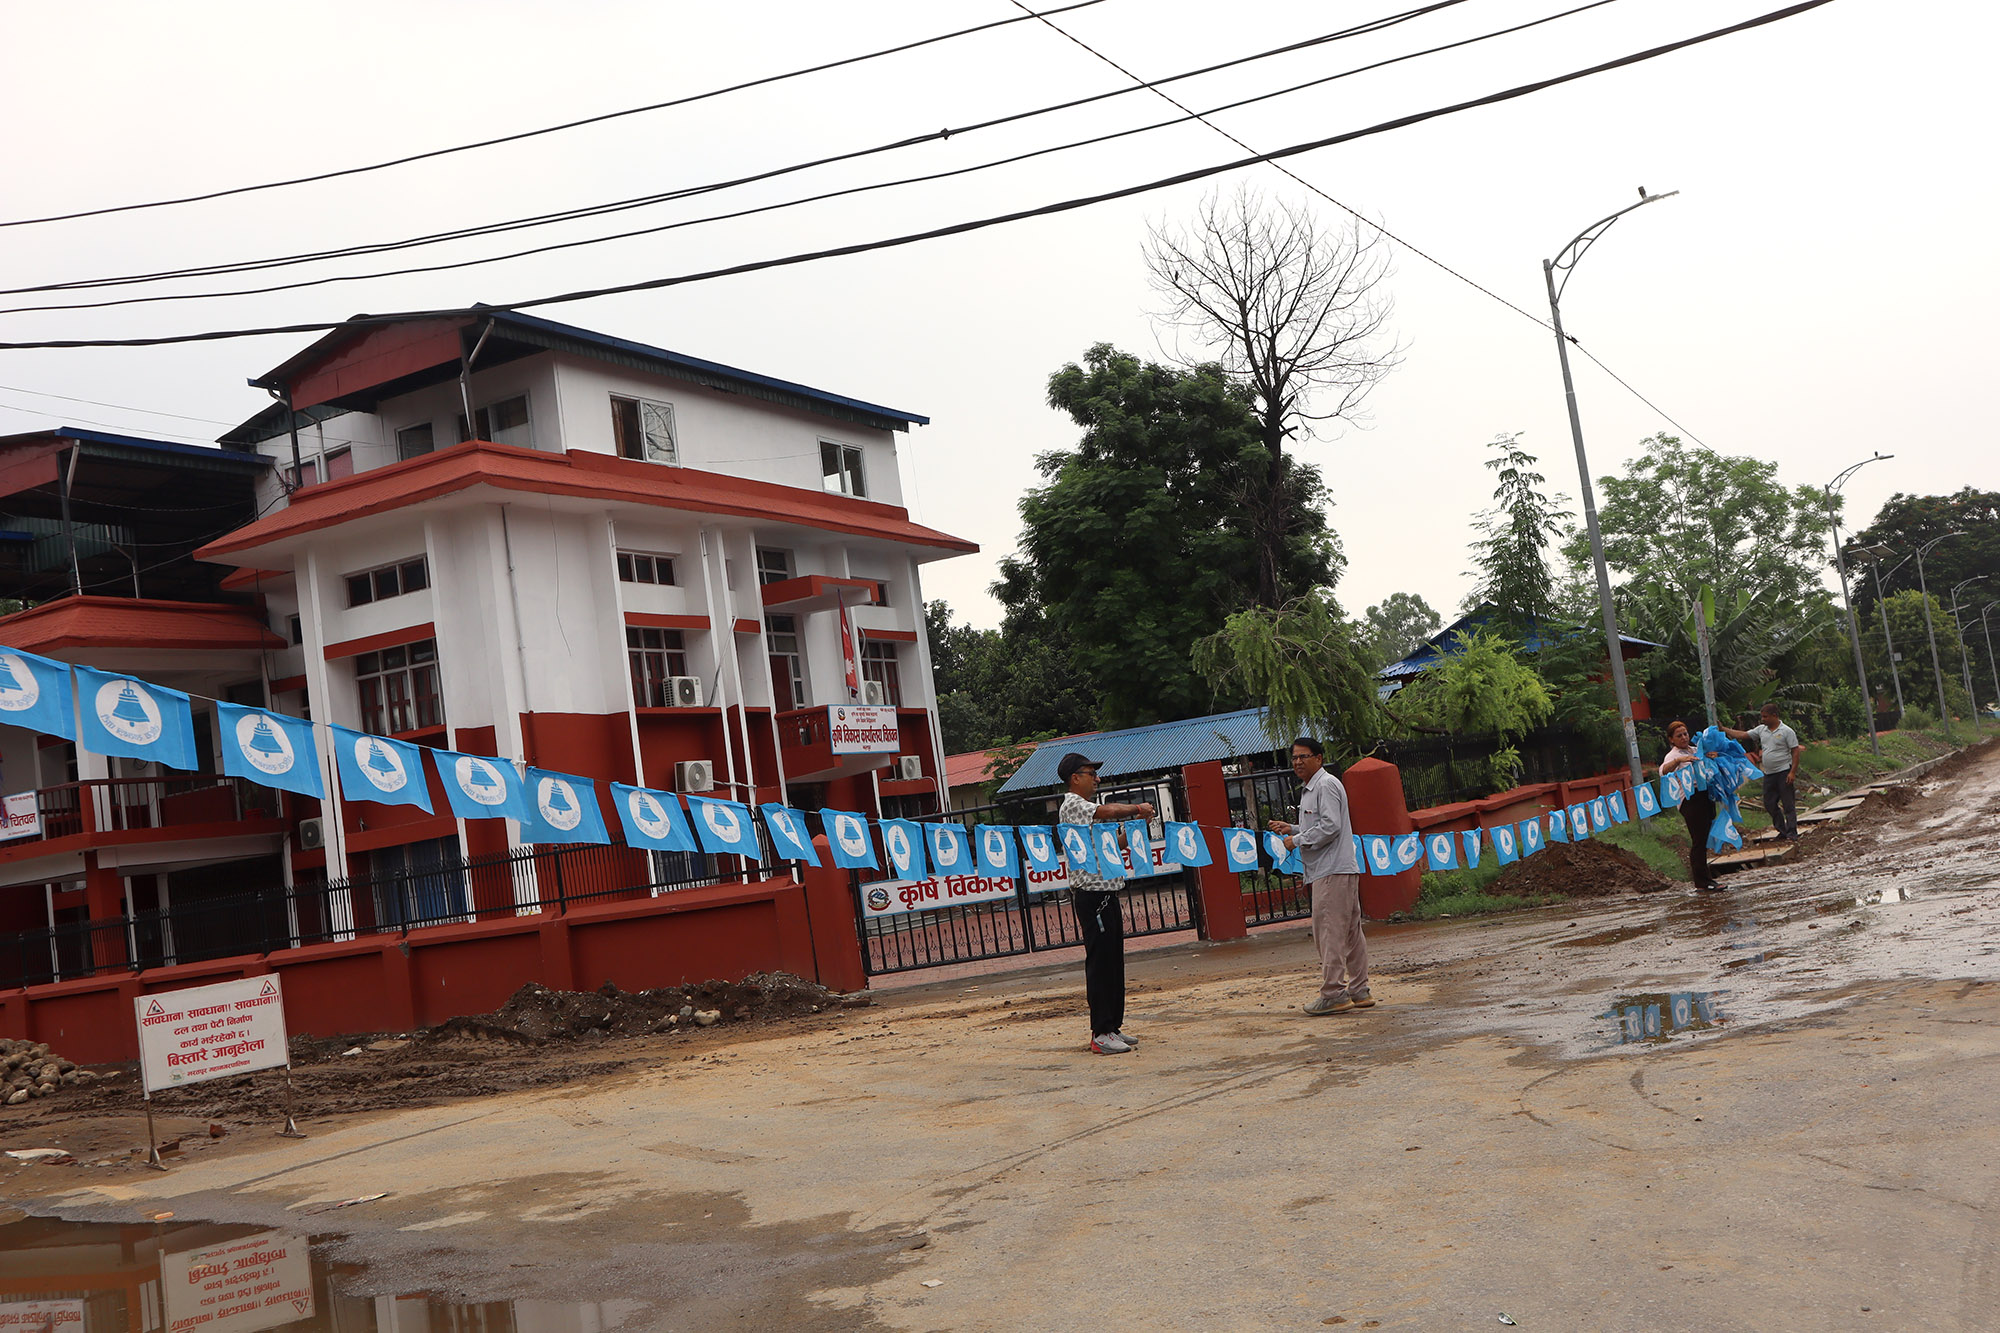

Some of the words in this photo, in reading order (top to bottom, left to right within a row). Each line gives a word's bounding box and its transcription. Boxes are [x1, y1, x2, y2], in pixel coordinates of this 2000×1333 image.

[9, 813, 36, 828] चितवन
[191, 1023, 208, 1033] तथा
[210, 1018, 225, 1030] पेटी
[227, 1014, 253, 1026] निर्माण
[180, 1037, 199, 1049] कार्य
[167, 1048, 209, 1067] बिस्तारै
[212, 1039, 265, 1059] जानुहोला
